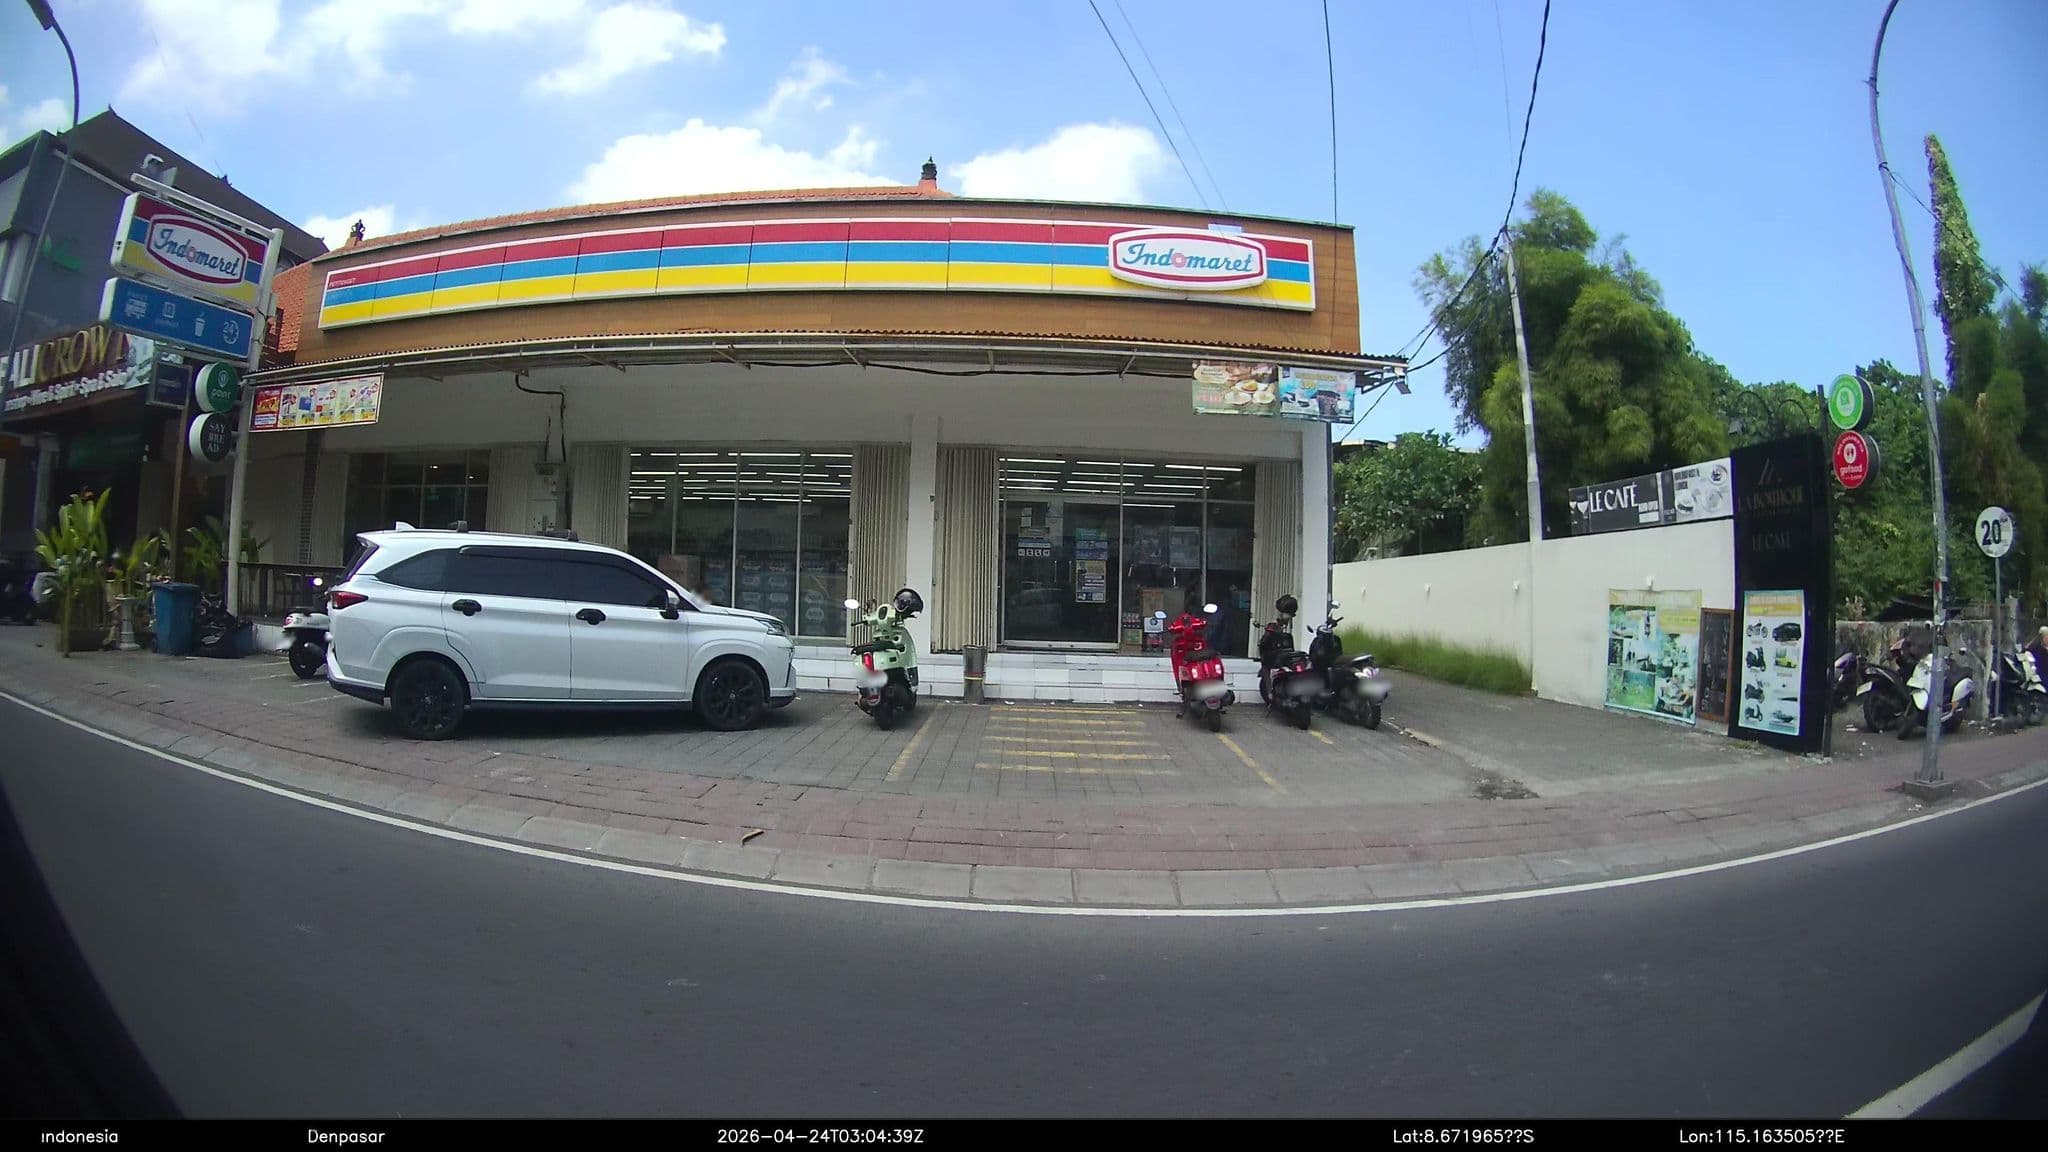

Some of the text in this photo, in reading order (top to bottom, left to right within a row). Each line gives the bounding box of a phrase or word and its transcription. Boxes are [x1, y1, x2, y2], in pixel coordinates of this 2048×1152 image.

[154, 228, 240, 276] Indomaret
[1121, 242, 1253, 273] Indomaret
[1589, 490, 1603, 513] LE
[1980, 519, 2002, 546] 20
